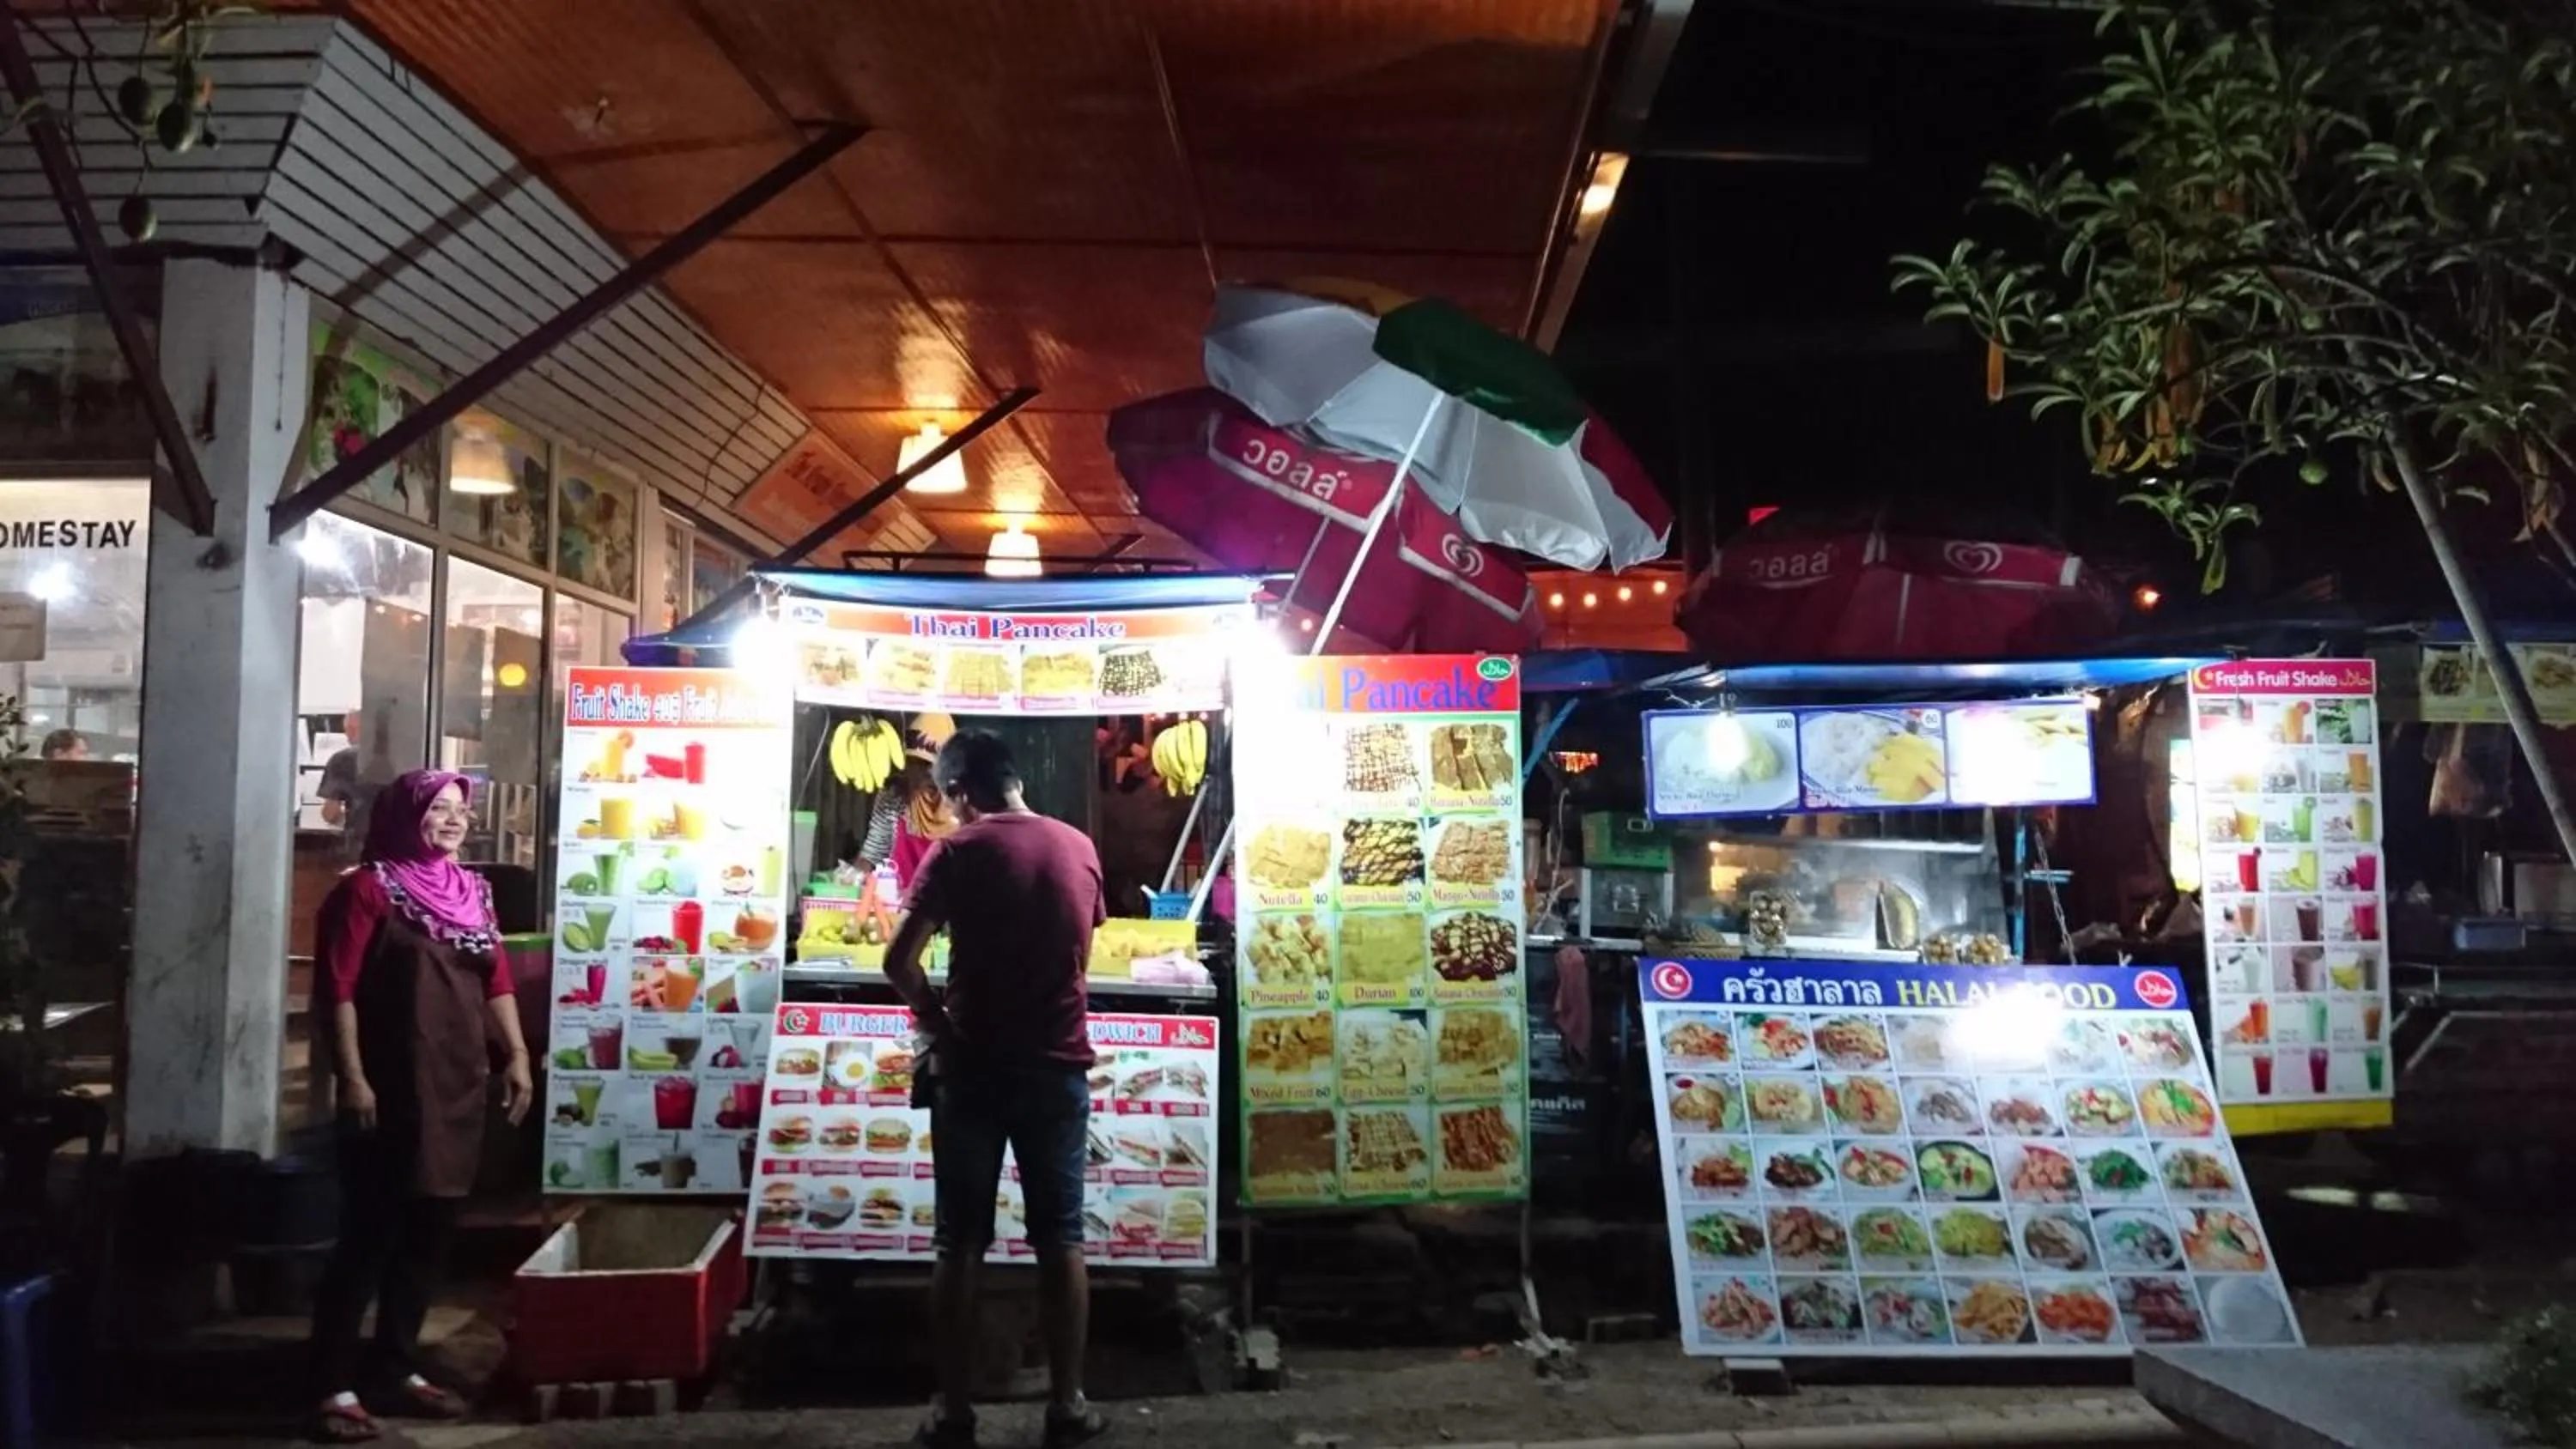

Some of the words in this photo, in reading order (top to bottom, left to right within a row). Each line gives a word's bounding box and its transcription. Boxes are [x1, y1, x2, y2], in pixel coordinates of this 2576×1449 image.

[1242, 439, 1350, 501] วอลล์
[906, 613, 978, 639] Thai
[990, 615, 1126, 640] Pancake
[1341, 665, 1498, 711] Pancake
[2215, 670, 2255, 687] Fresh
[2257, 671, 2289, 687] Fruit
[2292, 670, 2337, 687] Shake
[573, 684, 605, 720] Fruit
[609, 683, 651, 722] Shake
[1314, 892, 1328, 904] 40
[1406, 889, 1422, 902] 50
[1500, 888, 1516, 901] 50
[1250, 989, 1309, 1004] Pineapple
[1315, 990, 1330, 1003] 40
[1353, 987, 1398, 999] Durian
[1722, 967, 1884, 1006] ครัวฮาลาล
[1896, 979, 1997, 1006] HALA
[819, 1010, 910, 1035] BURGER
[1091, 1022, 1162, 1045] DWICH
